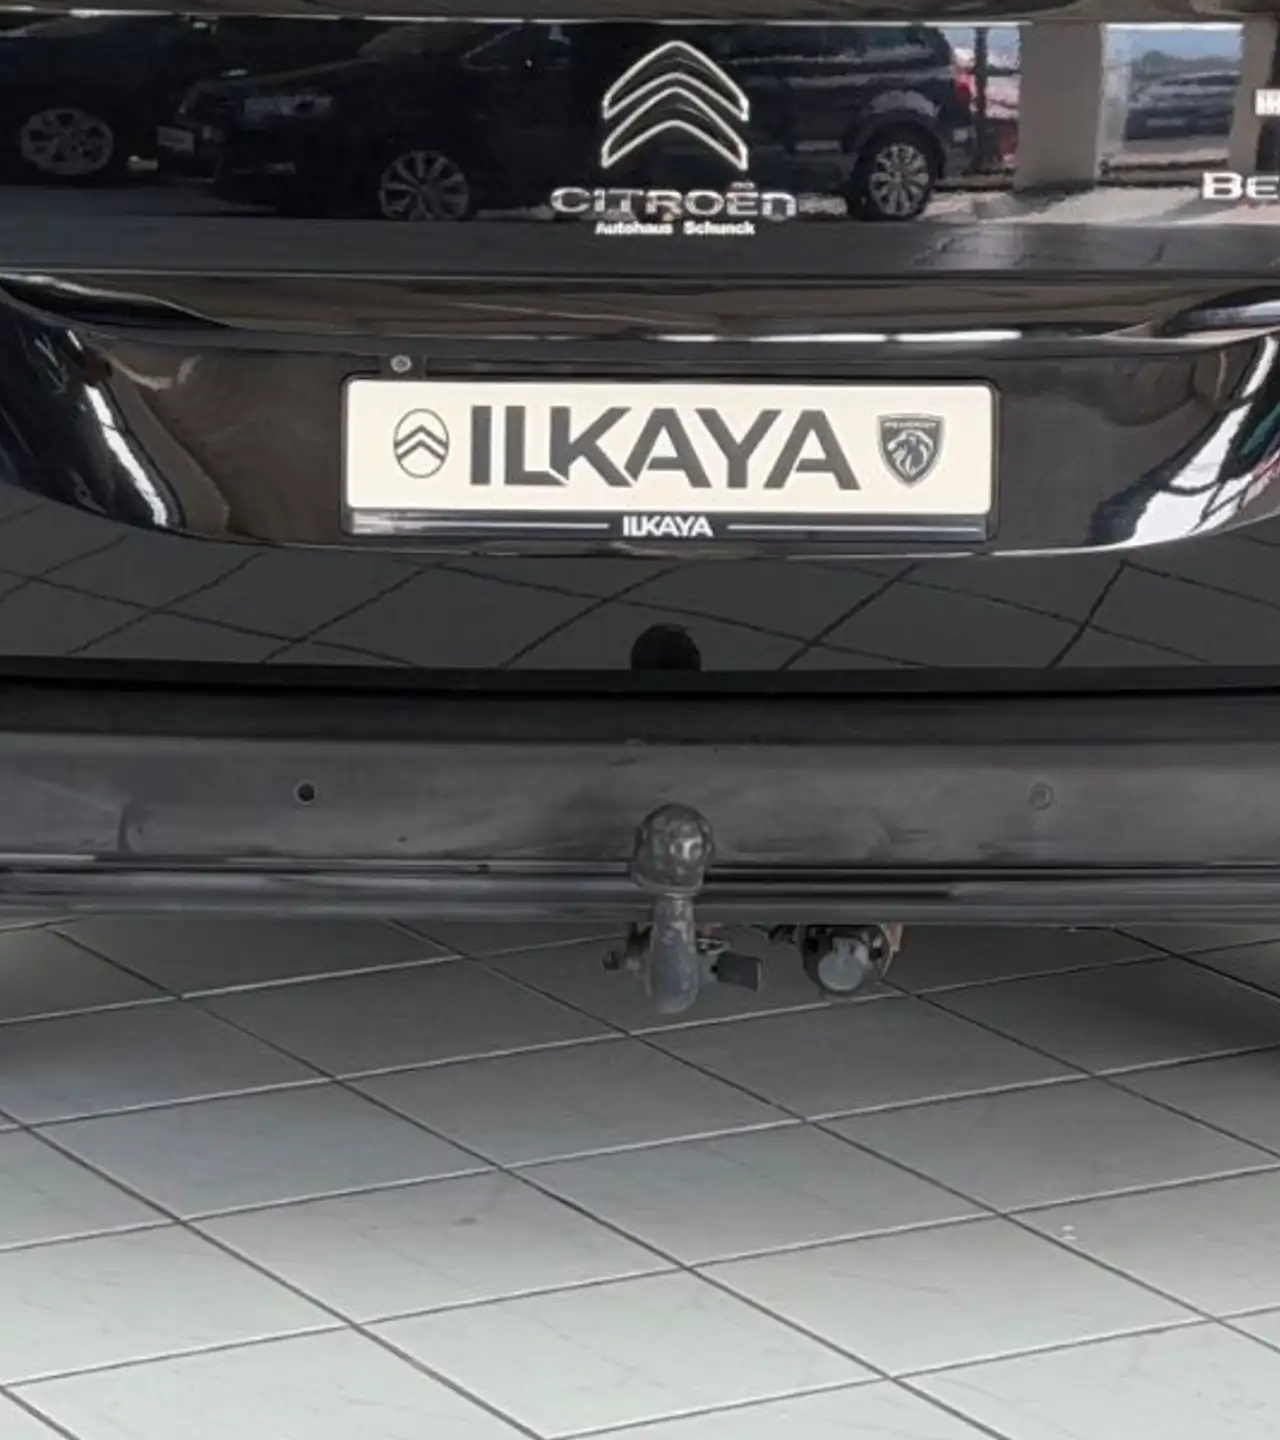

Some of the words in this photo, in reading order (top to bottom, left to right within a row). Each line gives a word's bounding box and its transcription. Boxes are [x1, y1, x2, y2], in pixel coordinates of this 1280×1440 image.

[550, 181, 797, 219] CITROËN
[595, 221, 674, 235] Autohaus
[683, 220, 756, 235] Schunck
[470, 405, 861, 490] ILKAYA
[622, 515, 714, 537] ILKAYA
